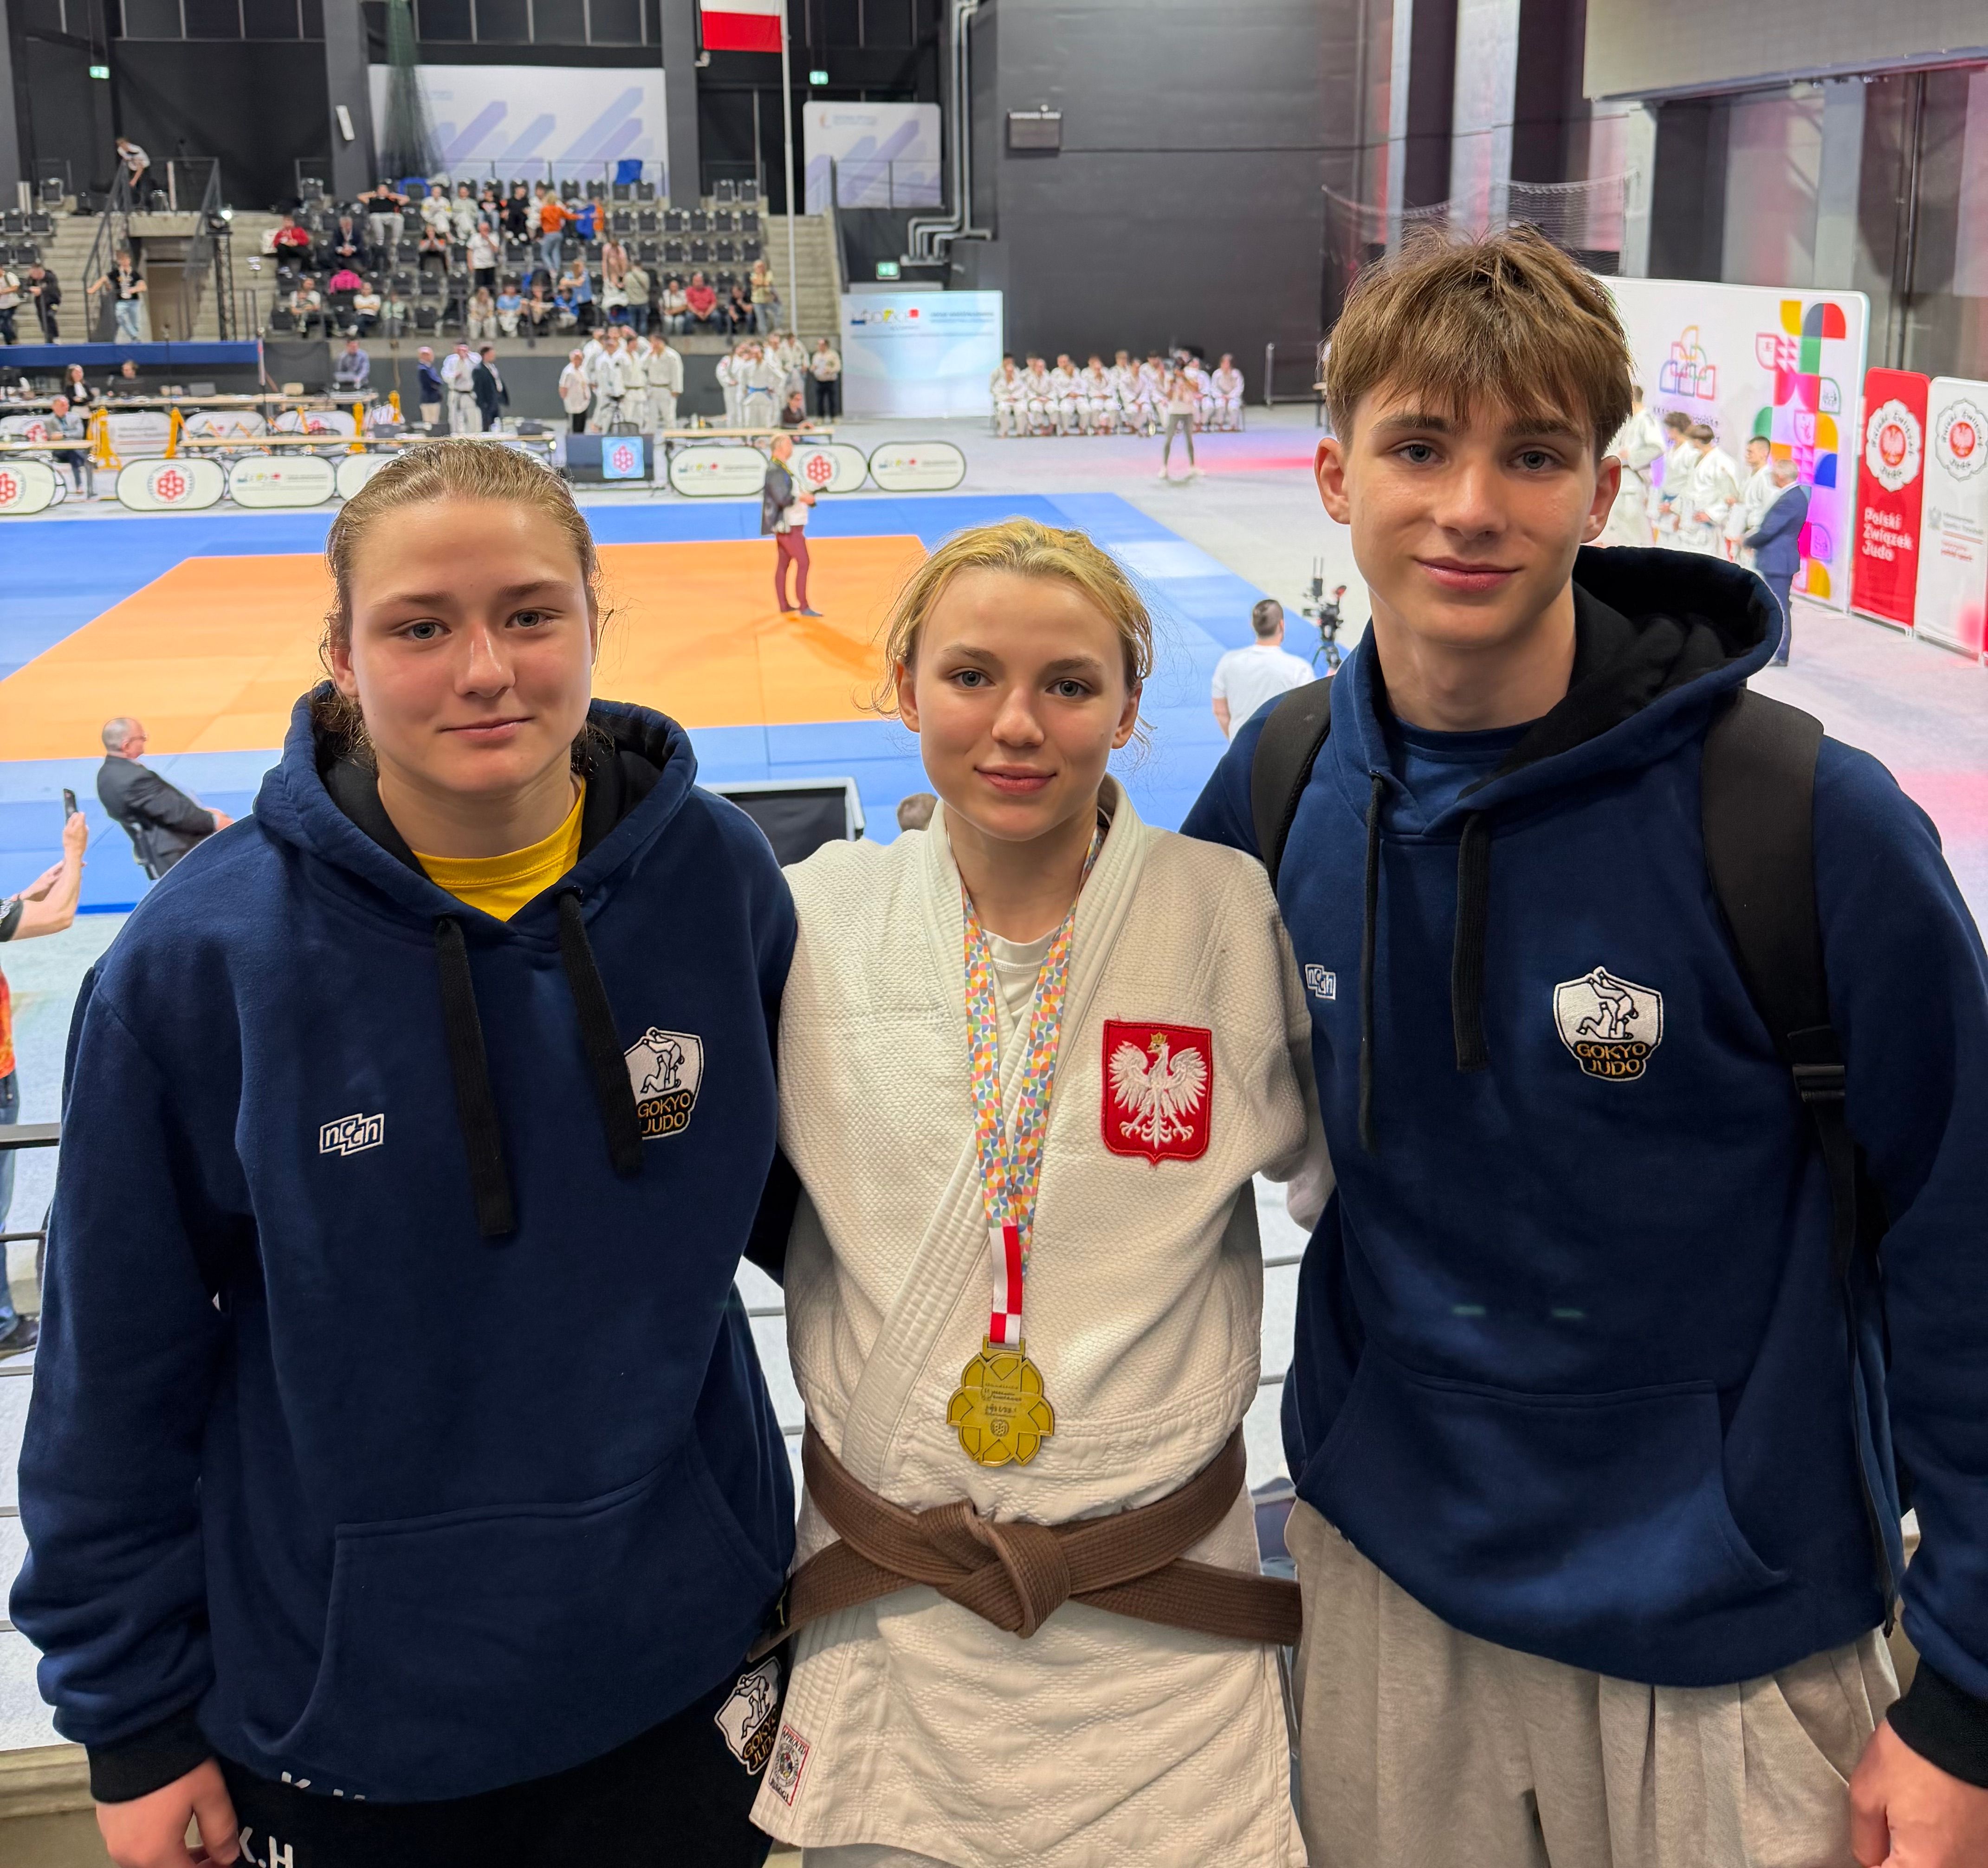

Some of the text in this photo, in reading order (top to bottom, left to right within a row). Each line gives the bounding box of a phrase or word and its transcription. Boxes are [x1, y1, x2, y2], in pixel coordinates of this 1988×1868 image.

[1864, 506, 1902, 530] Polski
[1863, 522, 1913, 550] Związek
[1862, 539, 1895, 562] Judo
[1576, 1043, 1647, 1060] GOKYO
[1588, 1059, 1640, 1075] JUDO
[637, 1092, 691, 1118] GOKYO
[641, 1112, 686, 1134] JUDO
